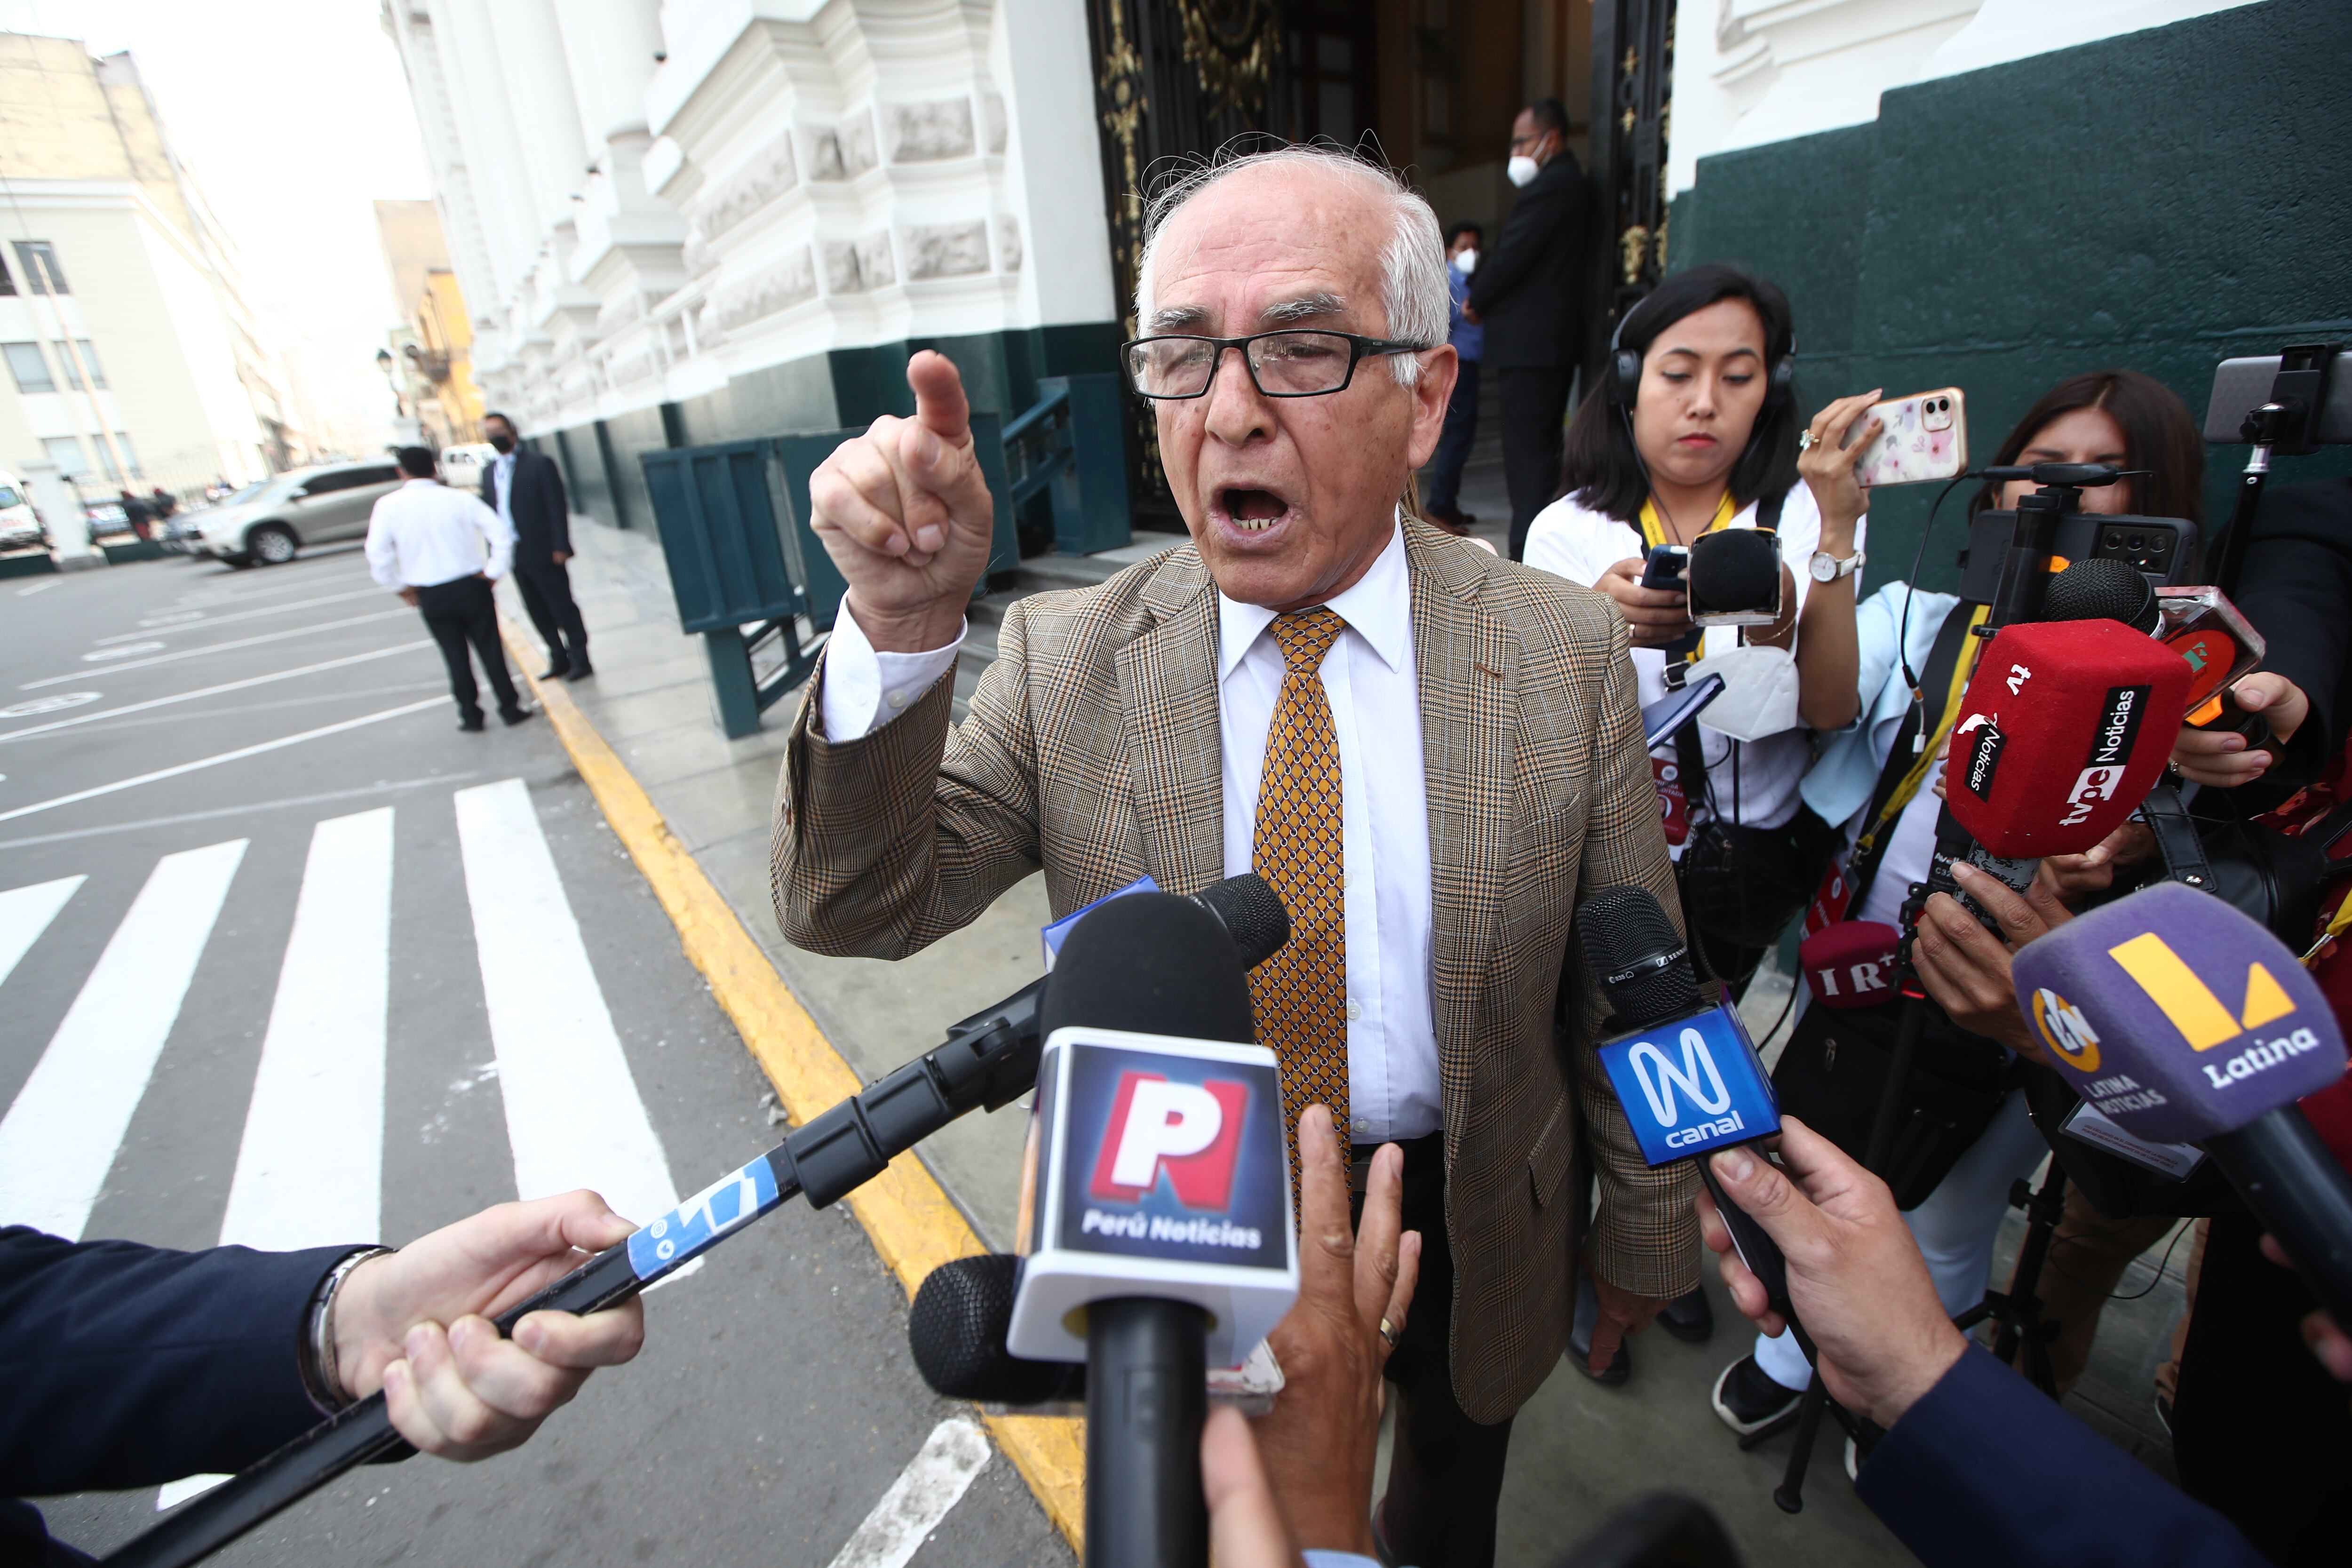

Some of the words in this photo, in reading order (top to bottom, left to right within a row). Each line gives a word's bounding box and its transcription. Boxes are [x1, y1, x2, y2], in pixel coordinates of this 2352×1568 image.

[2006, 664, 2031, 695] tv
[2095, 690, 2134, 762] Noticias
[1971, 727, 2000, 791] Noticias
[2202, 1027, 2320, 1090] Latina
[2083, 1074, 2140, 1098] LATINA
[2095, 1088, 2167, 1115] NOTICIAS
[1666, 1110, 1745, 1148] canal
[1082, 1208, 1147, 1239] Perú
[1150, 1214, 1262, 1250] Noticias
